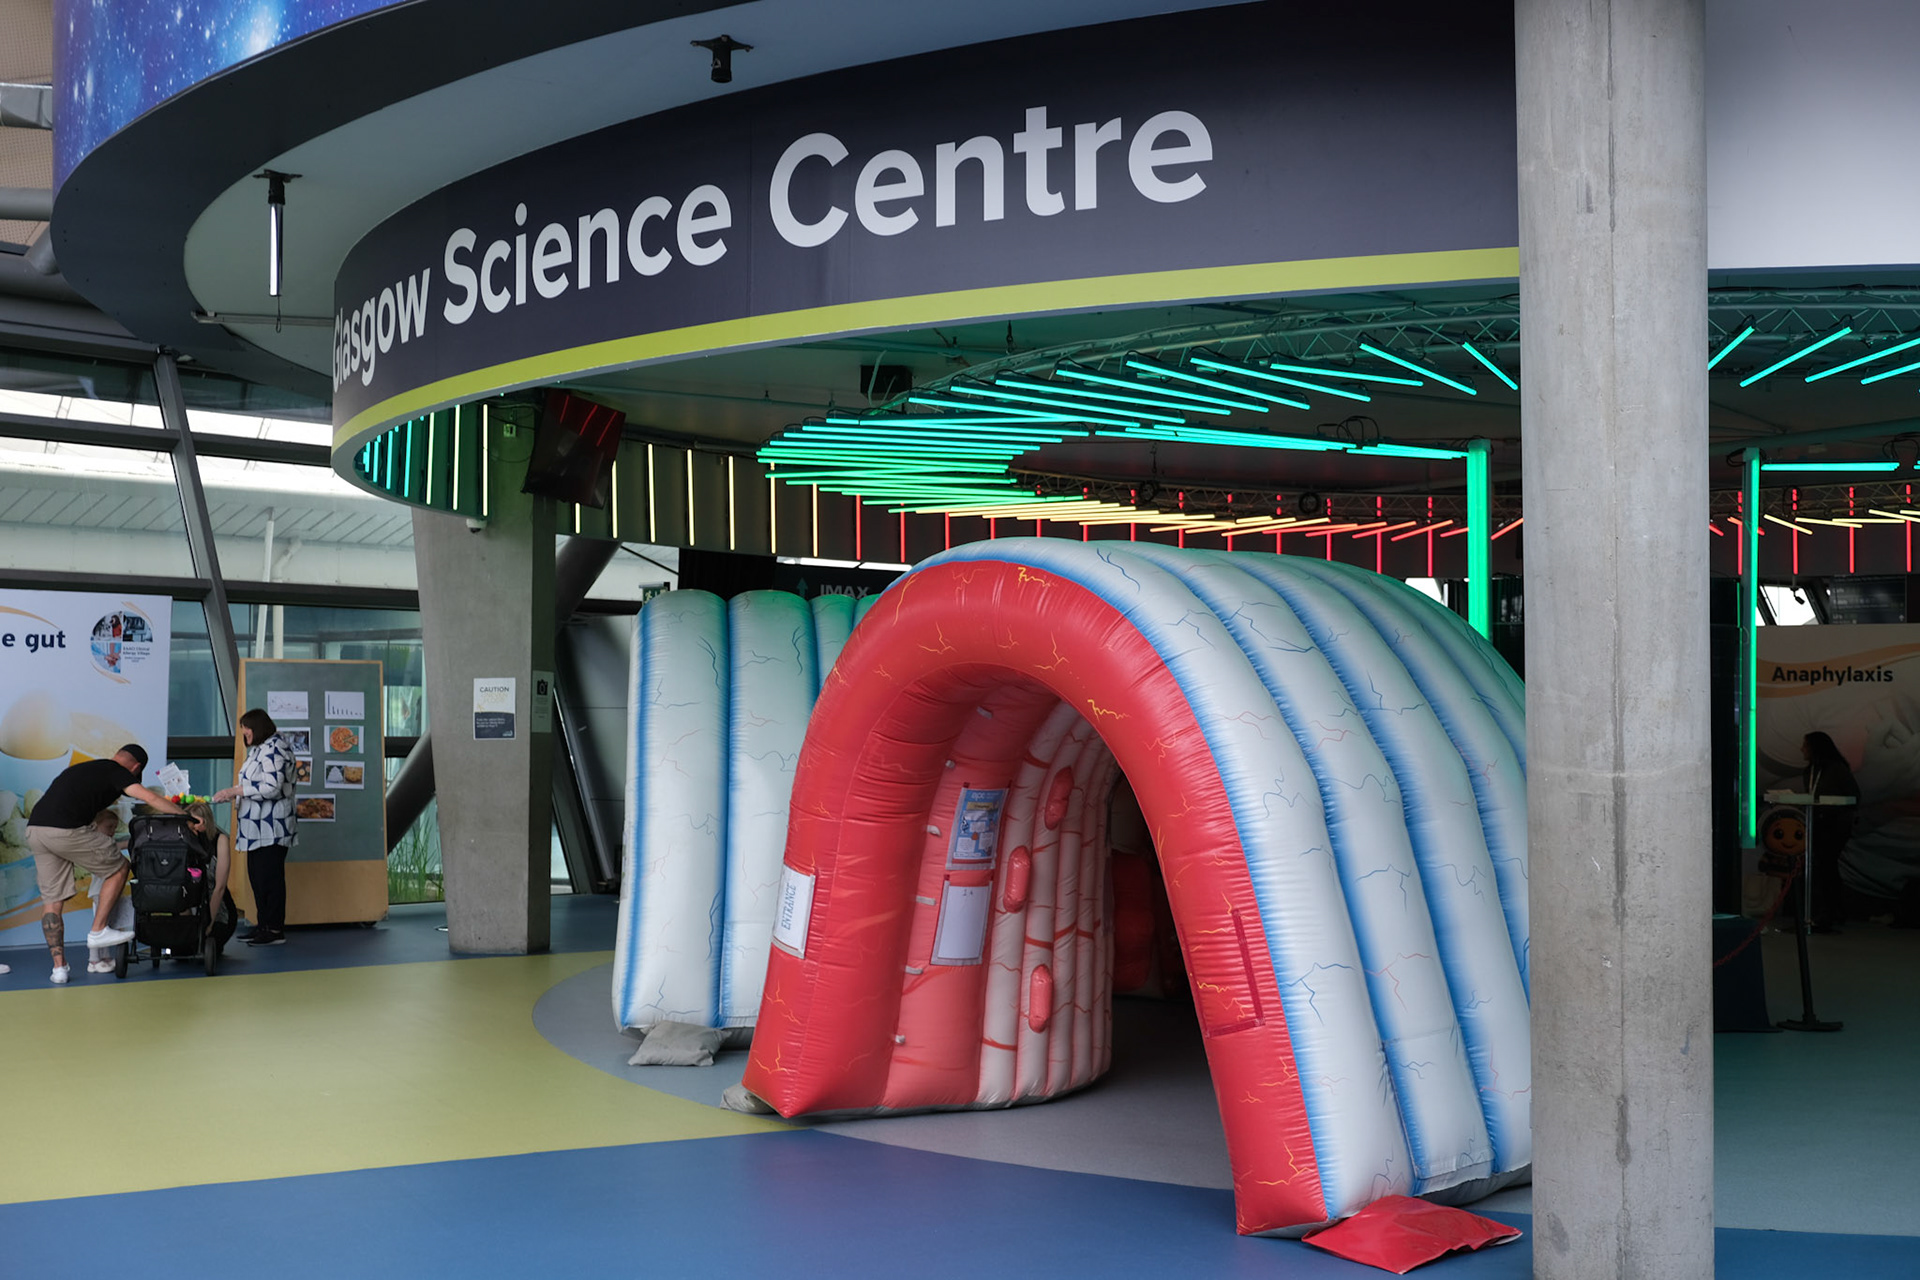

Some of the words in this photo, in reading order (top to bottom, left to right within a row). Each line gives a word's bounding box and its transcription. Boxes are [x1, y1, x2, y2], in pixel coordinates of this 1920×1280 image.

[332, 268, 431, 393] Glasgow
[443, 184, 732, 325] Science
[769, 106, 1214, 248] Centre
[820, 584, 869, 599] IMAX
[25, 630, 66, 653] gut
[1772, 666, 1893, 686] Anaphylaxis
[780, 882, 797, 931] ENTRANCE
